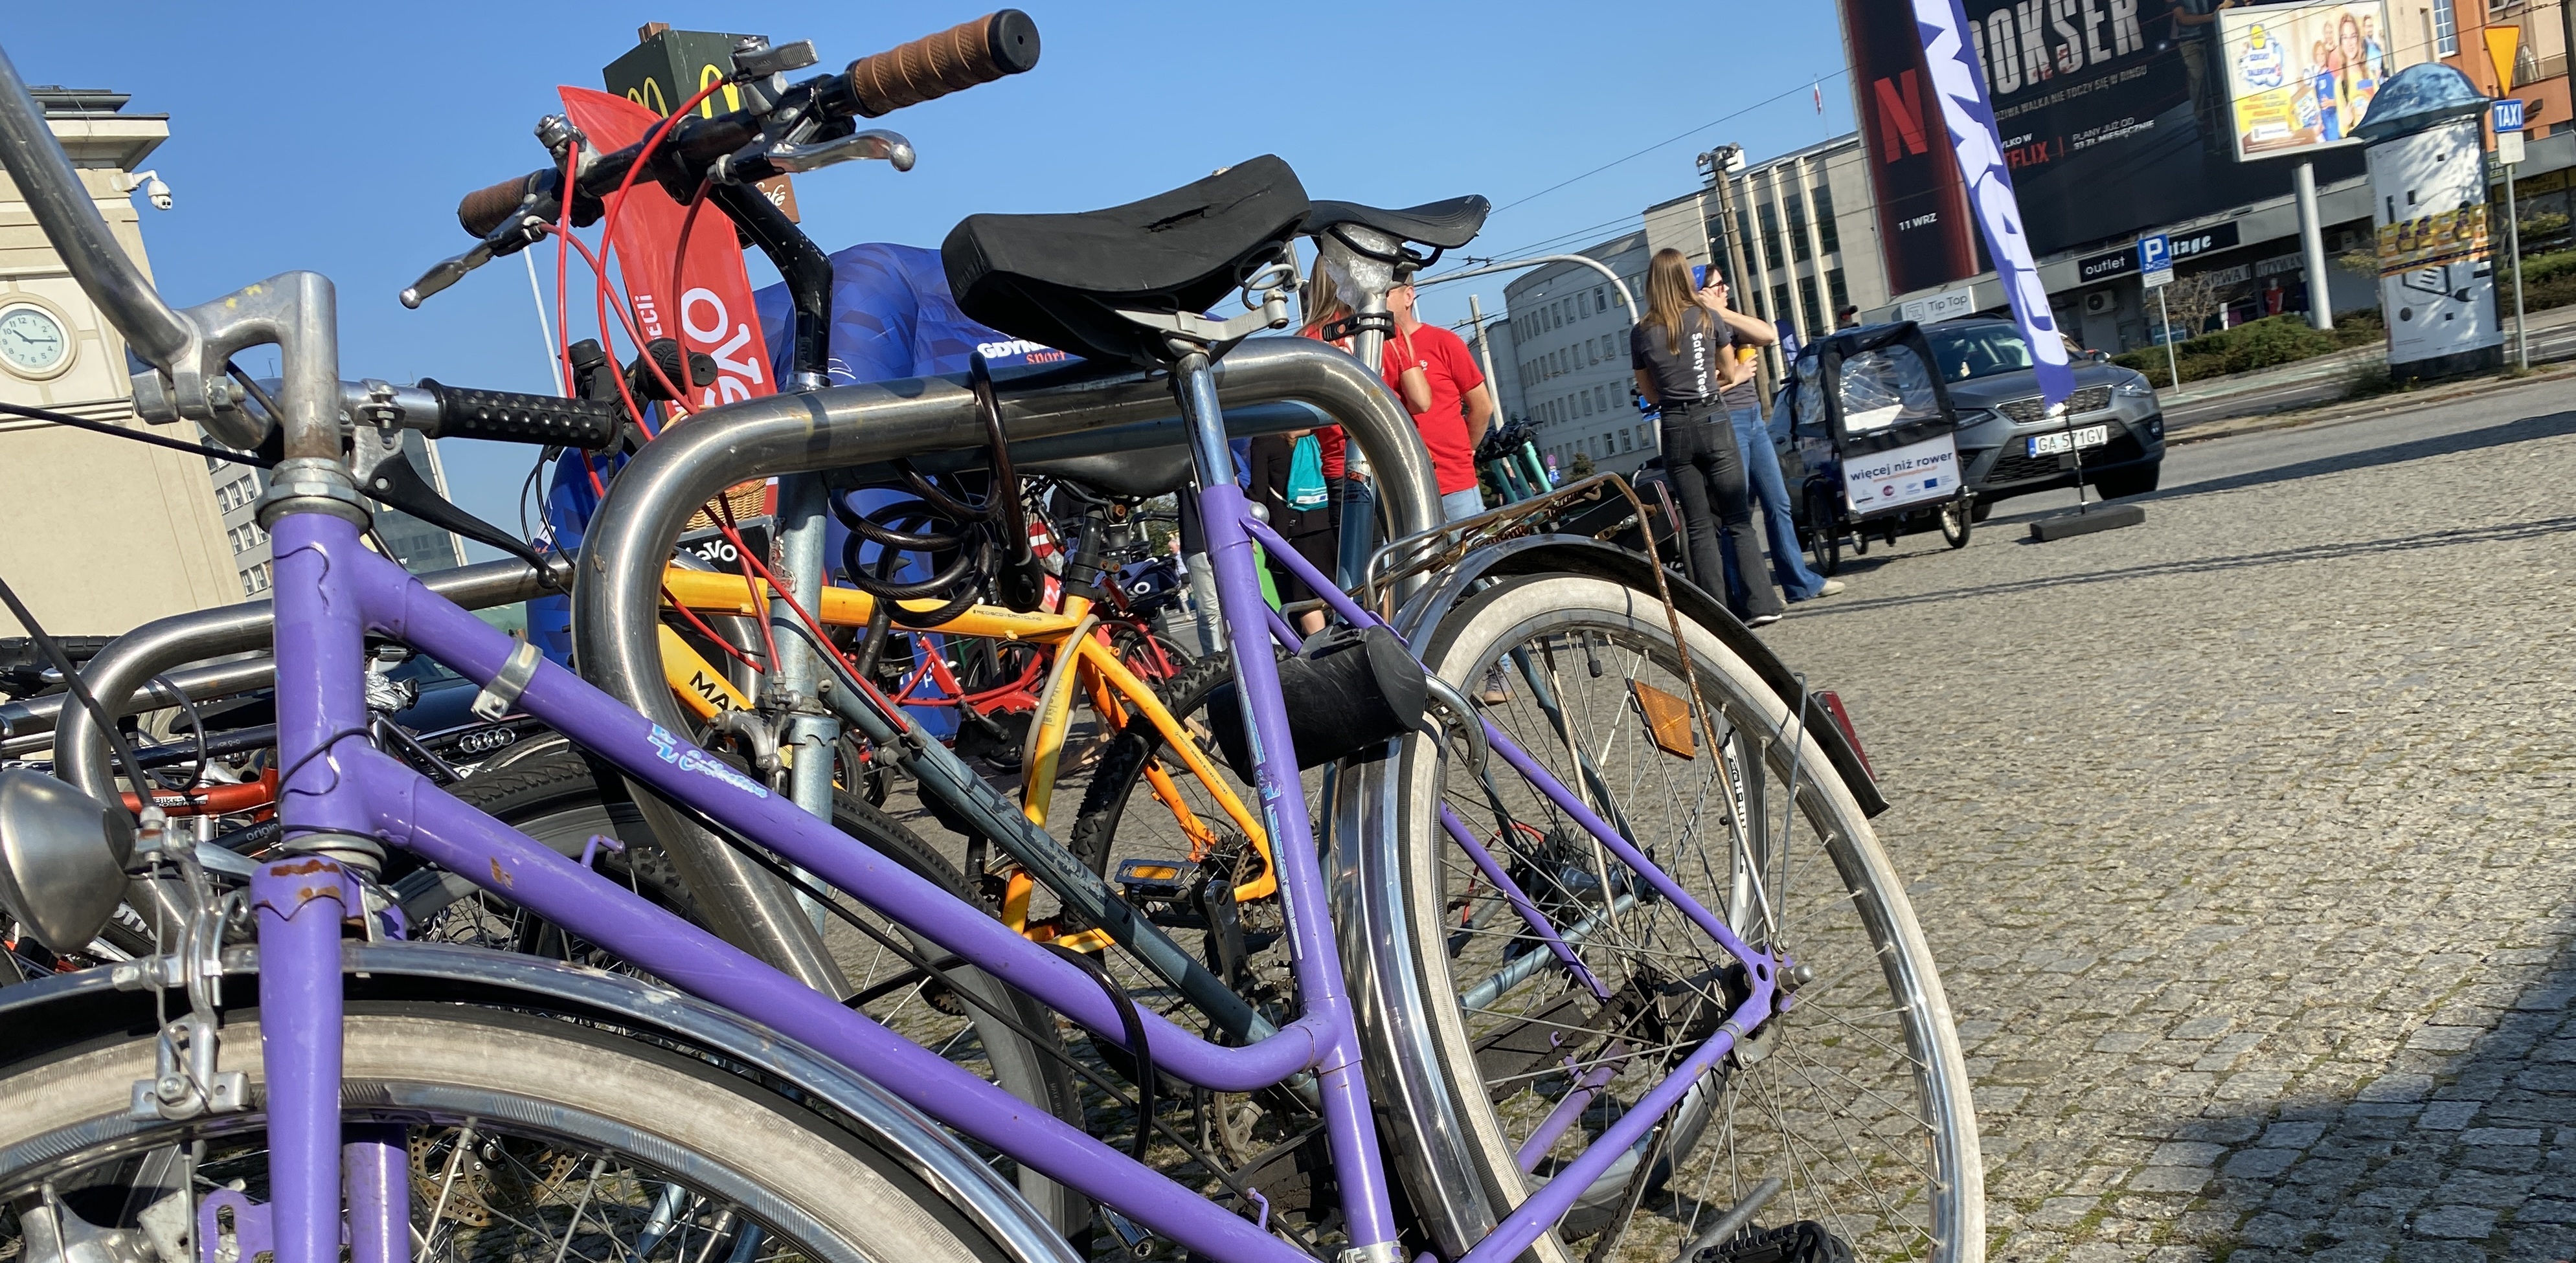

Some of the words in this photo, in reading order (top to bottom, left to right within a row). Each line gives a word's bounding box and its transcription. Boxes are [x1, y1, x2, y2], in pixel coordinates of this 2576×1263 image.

[2021, 97, 2050, 113] WALKA
[2051, 90, 2065, 104] NIE
[2066, 81, 2093, 98] TOCZY
[2108, 74, 2119, 85] W
[2496, 104, 2522, 128] TAXI
[2024, 133, 2033, 142] W
[2073, 127, 2102, 142] PLANY
[2121, 117, 2135, 127] OD
[1899, 221, 1911, 231] 11
[1912, 212, 1938, 229] WRZ
[2145, 238, 2164, 262] P
[2086, 256, 2125, 275] outlet
[1928, 300, 1945, 311] Tip
[1946, 295, 1968, 306] Top
[977, 340, 1050, 359] GDYN
[1692, 332, 1705, 370] Safety
[2039, 436, 2057, 451] GA
[2062, 427, 2103, 447] 571GV
[1850, 463, 1890, 481] więcej
[1894, 458, 1913, 471] niż
[1916, 453, 1953, 467] rower
[688, 669, 747, 713] MA
